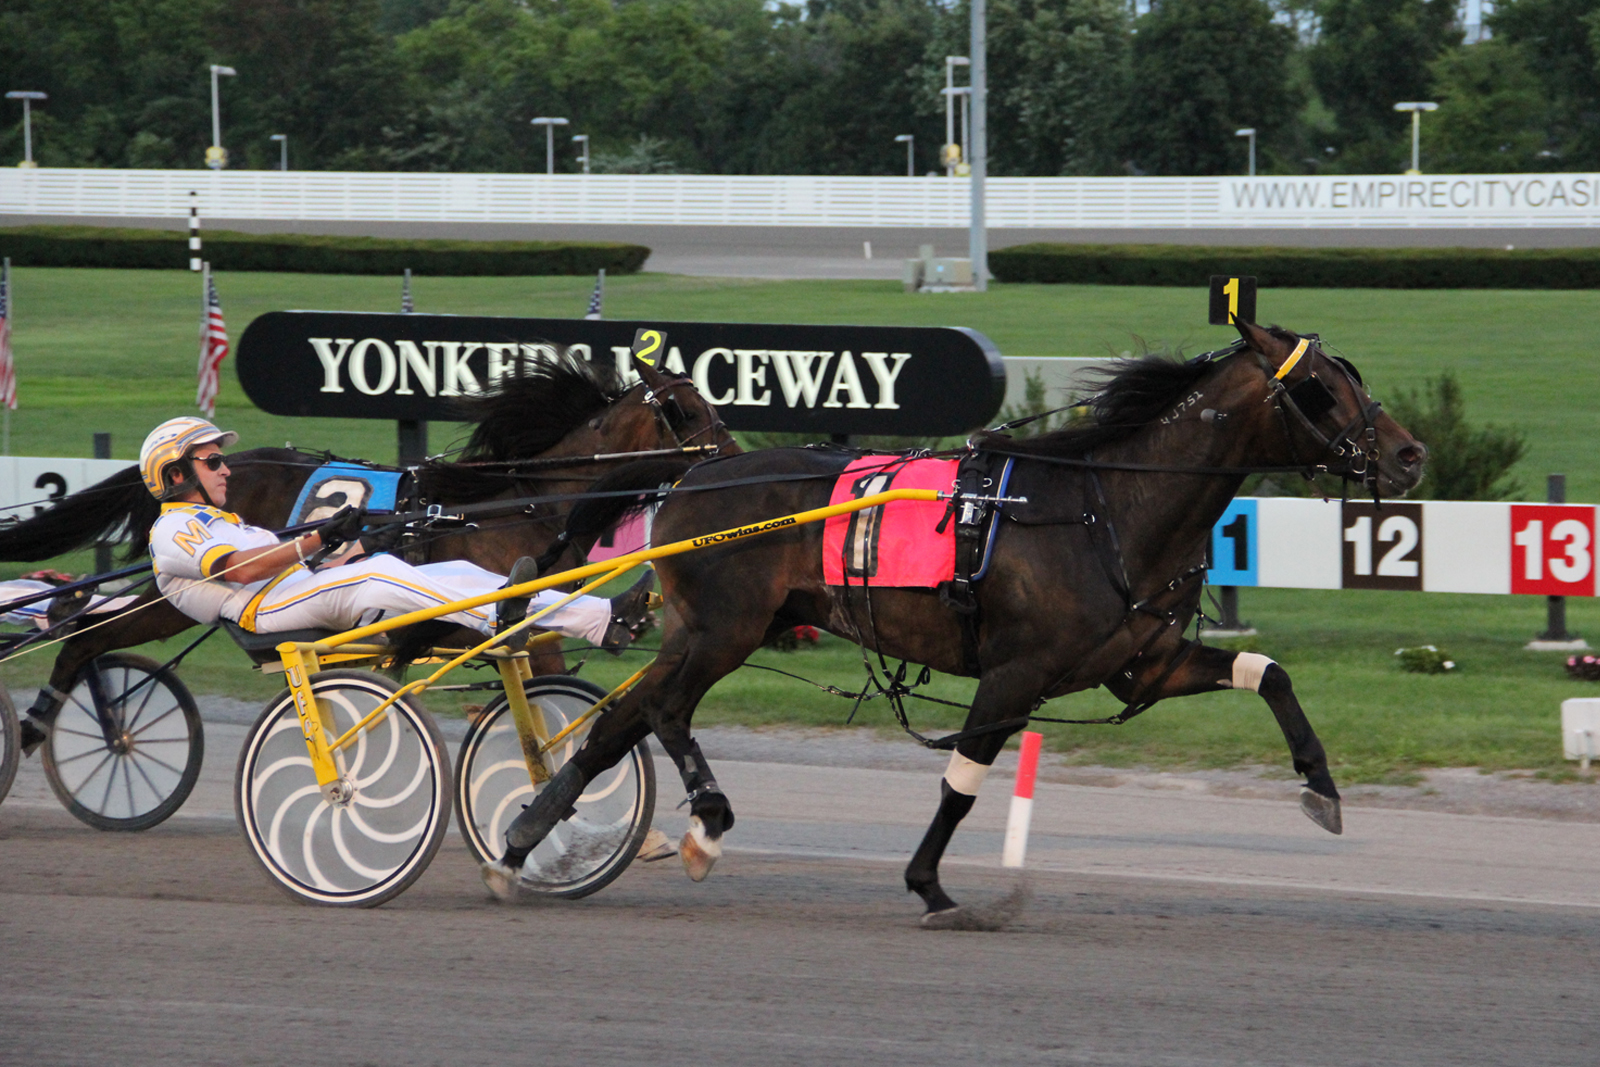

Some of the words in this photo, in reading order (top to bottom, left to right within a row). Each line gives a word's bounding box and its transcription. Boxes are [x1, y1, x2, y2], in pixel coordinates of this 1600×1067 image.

[1231, 179, 1600, 208] WWW.EMPIRECITYCASI
[1223, 277, 1239, 325] 1
[635, 330, 662, 366] 2
[172, 519, 213, 558] M
[692, 517, 797, 547] UFOwins.com
[1344, 515, 1419, 577] 12
[1514, 519, 1592, 583] 13
